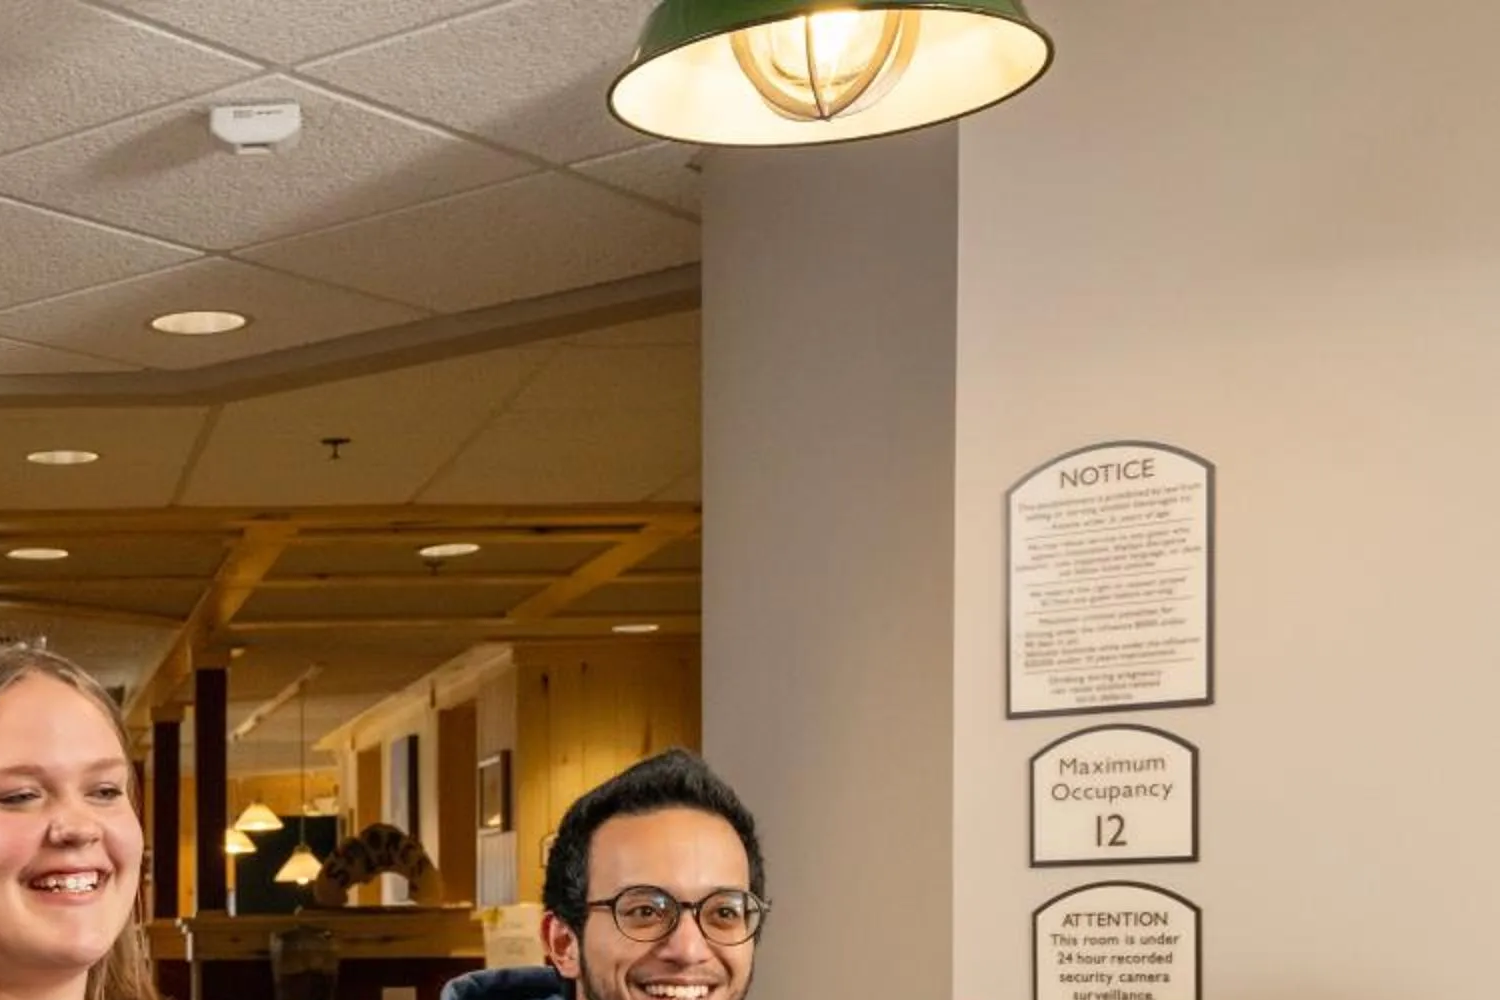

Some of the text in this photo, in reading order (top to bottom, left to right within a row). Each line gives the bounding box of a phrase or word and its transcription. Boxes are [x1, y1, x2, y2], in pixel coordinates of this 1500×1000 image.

[1060, 458, 1155, 488] NOTICE
[1059, 757, 1166, 776] Maximum
[1051, 779, 1173, 805] Occupancy
[1096, 814, 1127, 847] 12
[1062, 912, 1168, 926] ATTENTION
[1049, 932, 1180, 947] This room is under
[1058, 951, 1173, 965] 24 hour recorded
[1059, 971, 1170, 986] security camera
